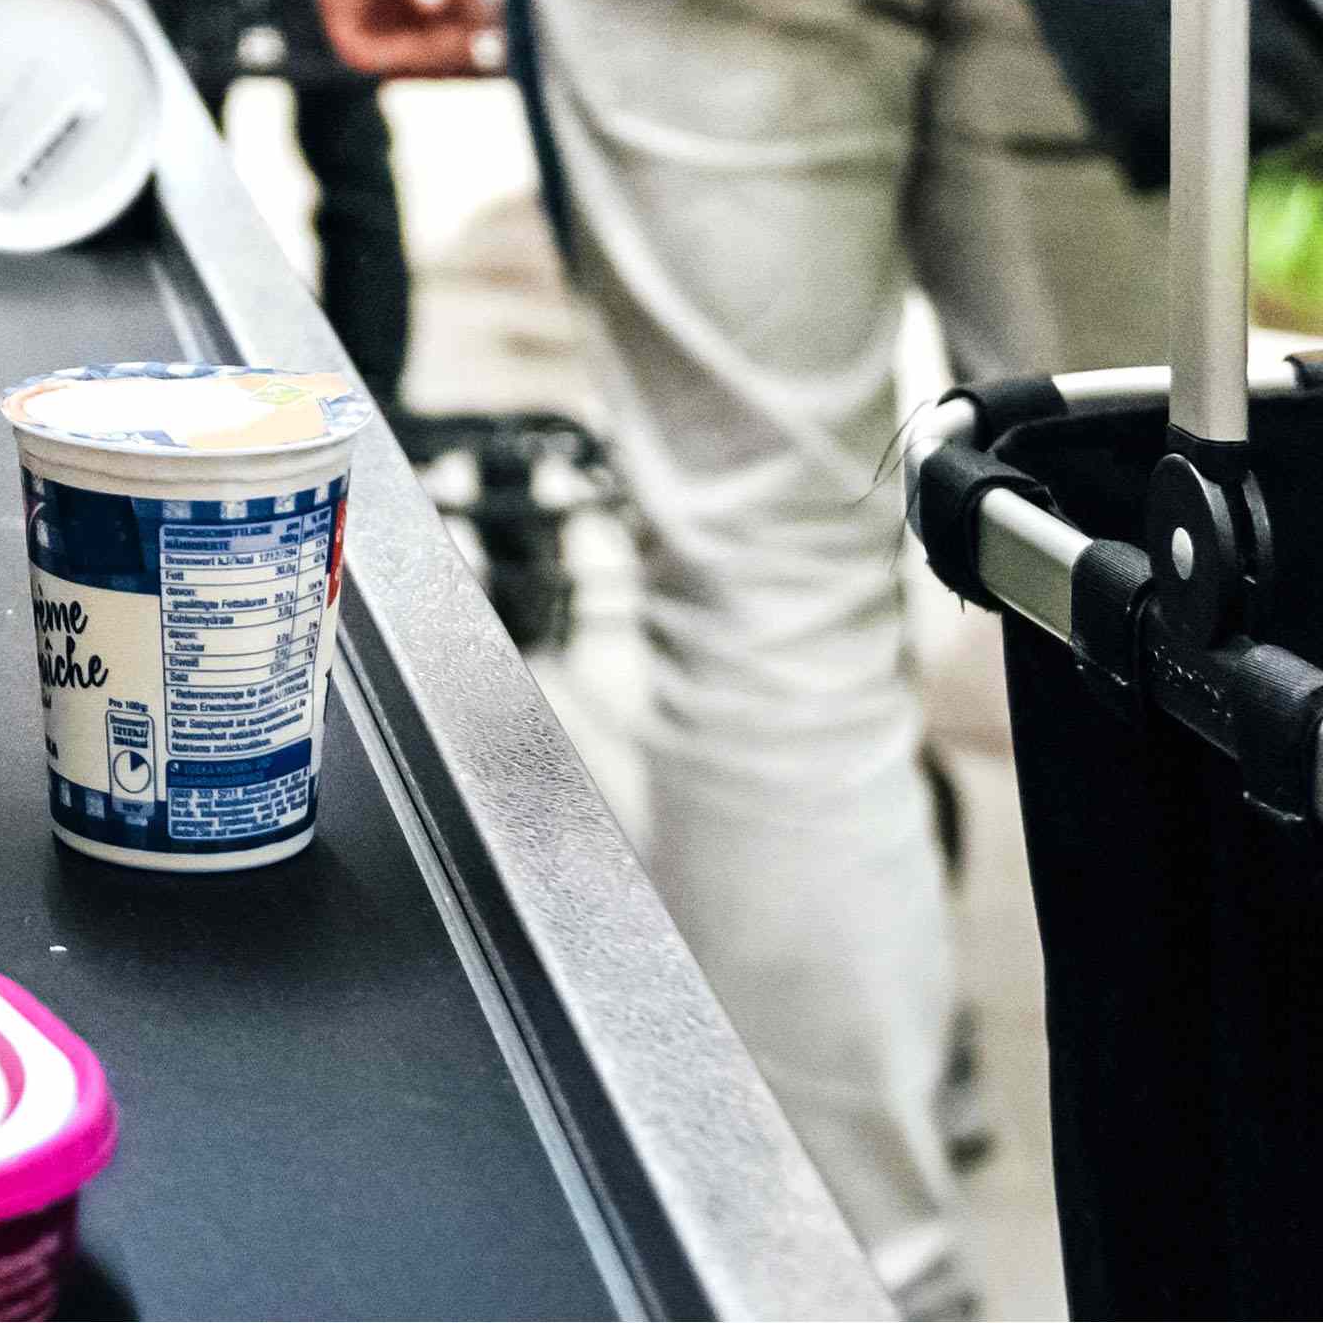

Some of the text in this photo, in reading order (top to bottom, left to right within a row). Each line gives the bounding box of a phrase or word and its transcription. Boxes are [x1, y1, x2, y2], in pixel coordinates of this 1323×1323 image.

[165, 555, 215, 566] Brennwert
[165, 570, 184, 581] Fett
[31, 583, 88, 634] ème
[167, 613, 234, 626] Kohlenhydrate
[174, 641, 205, 652] Zucker
[108, 698, 123, 709] Pro
